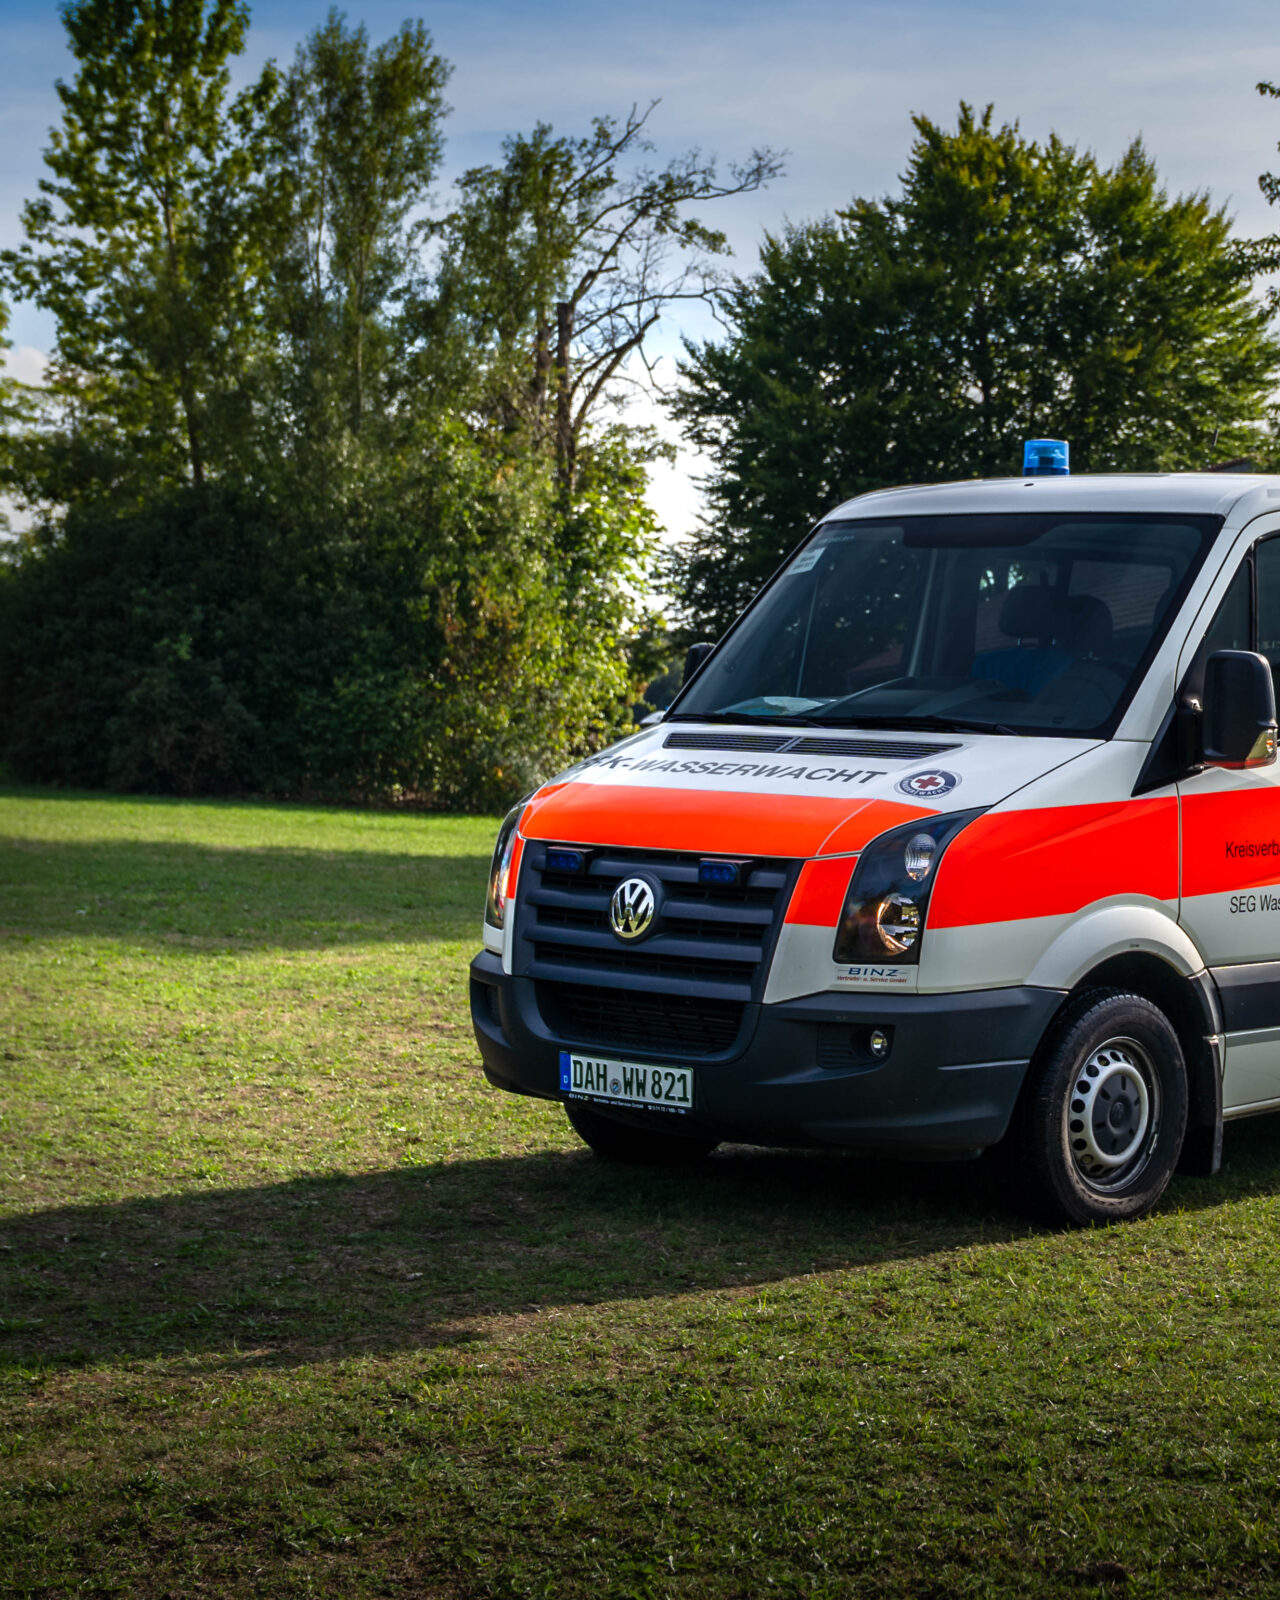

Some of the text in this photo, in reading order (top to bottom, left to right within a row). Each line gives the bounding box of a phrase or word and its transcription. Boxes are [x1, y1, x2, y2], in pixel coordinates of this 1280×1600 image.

[1229, 895, 1256, 914] SEG
[848, 967, 899, 977] BINZ
[572, 1059, 690, 1103] DAH WW 821
